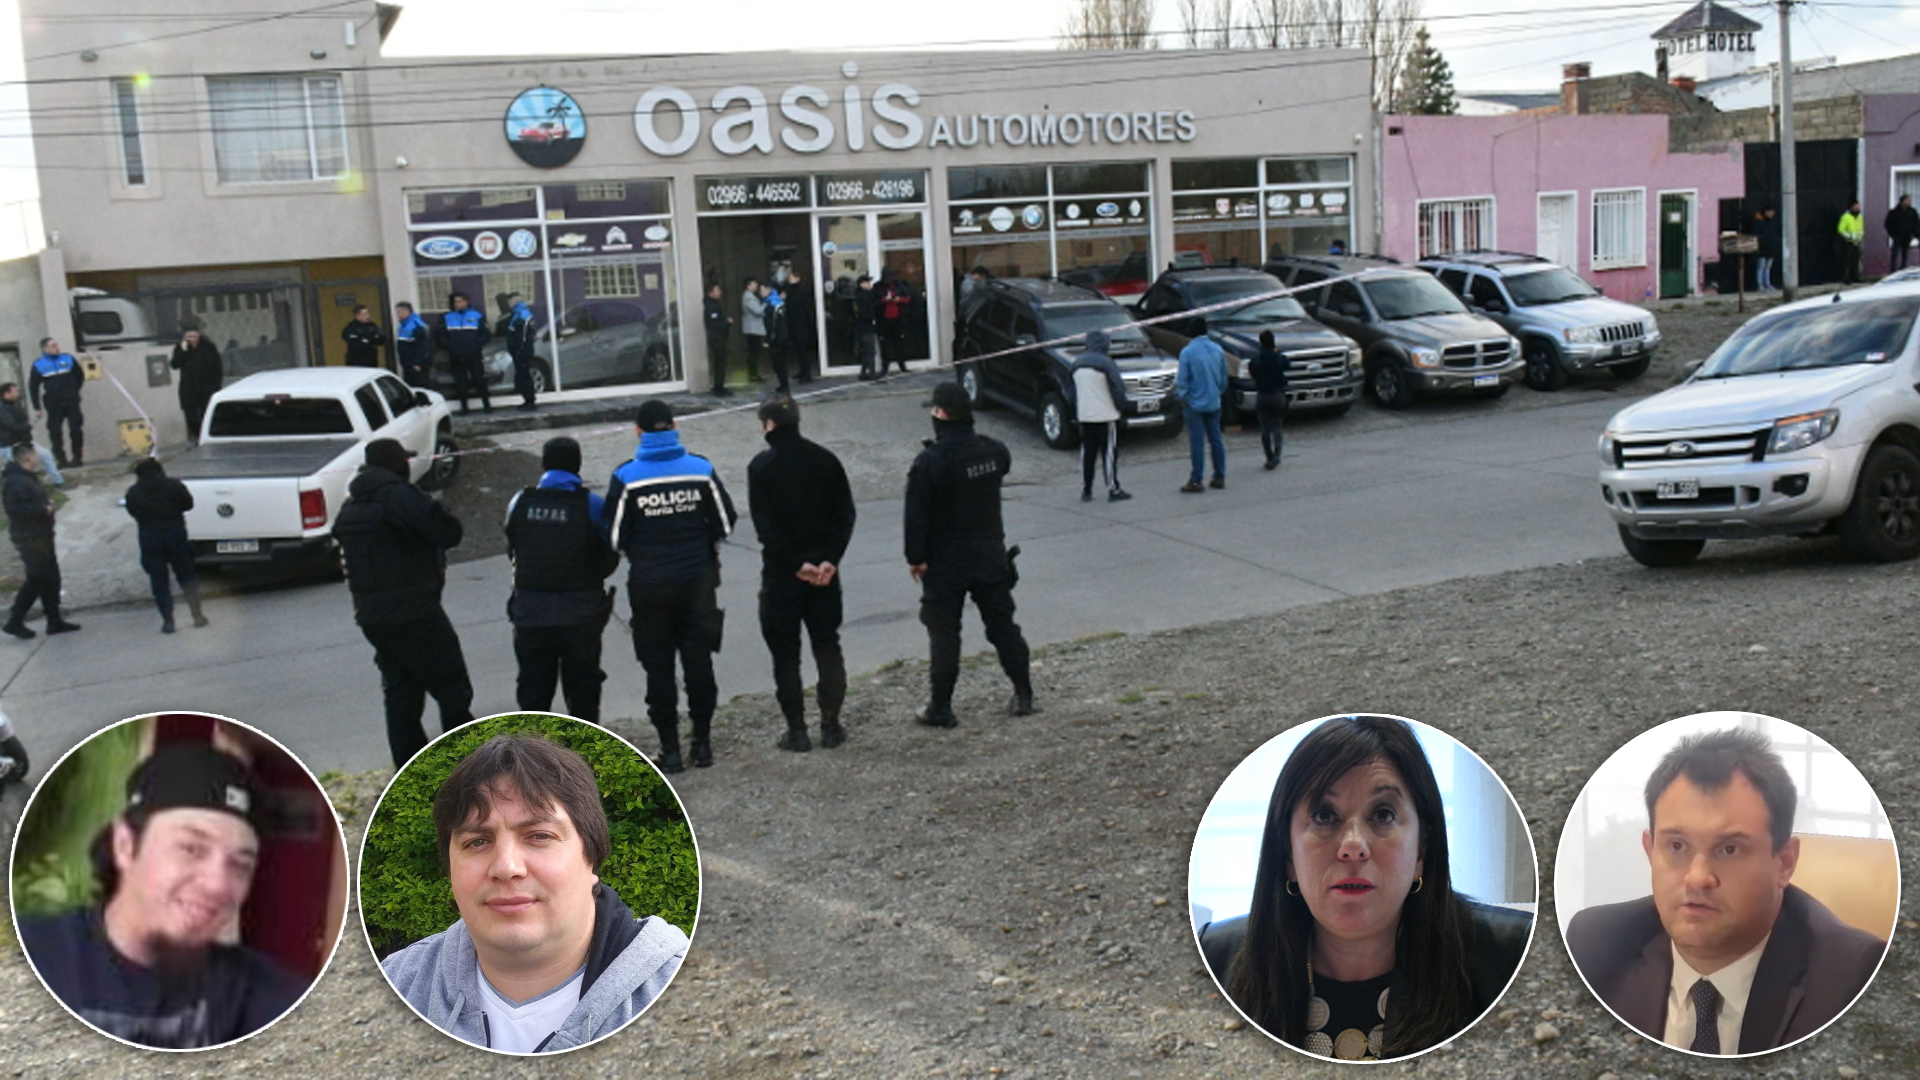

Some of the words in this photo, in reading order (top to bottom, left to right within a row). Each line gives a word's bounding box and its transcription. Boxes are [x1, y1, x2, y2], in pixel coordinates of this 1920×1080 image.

[1706, 32, 1755, 52] HOTEL
[634, 61, 925, 156] oasis
[929, 110, 1197, 148] AUTOMOTORES
[708, 185, 747, 205] 02966
[827, 181, 864, 200] 02966
[637, 489, 701, 509] POLICIA
[644, 505, 673, 517] Santa
